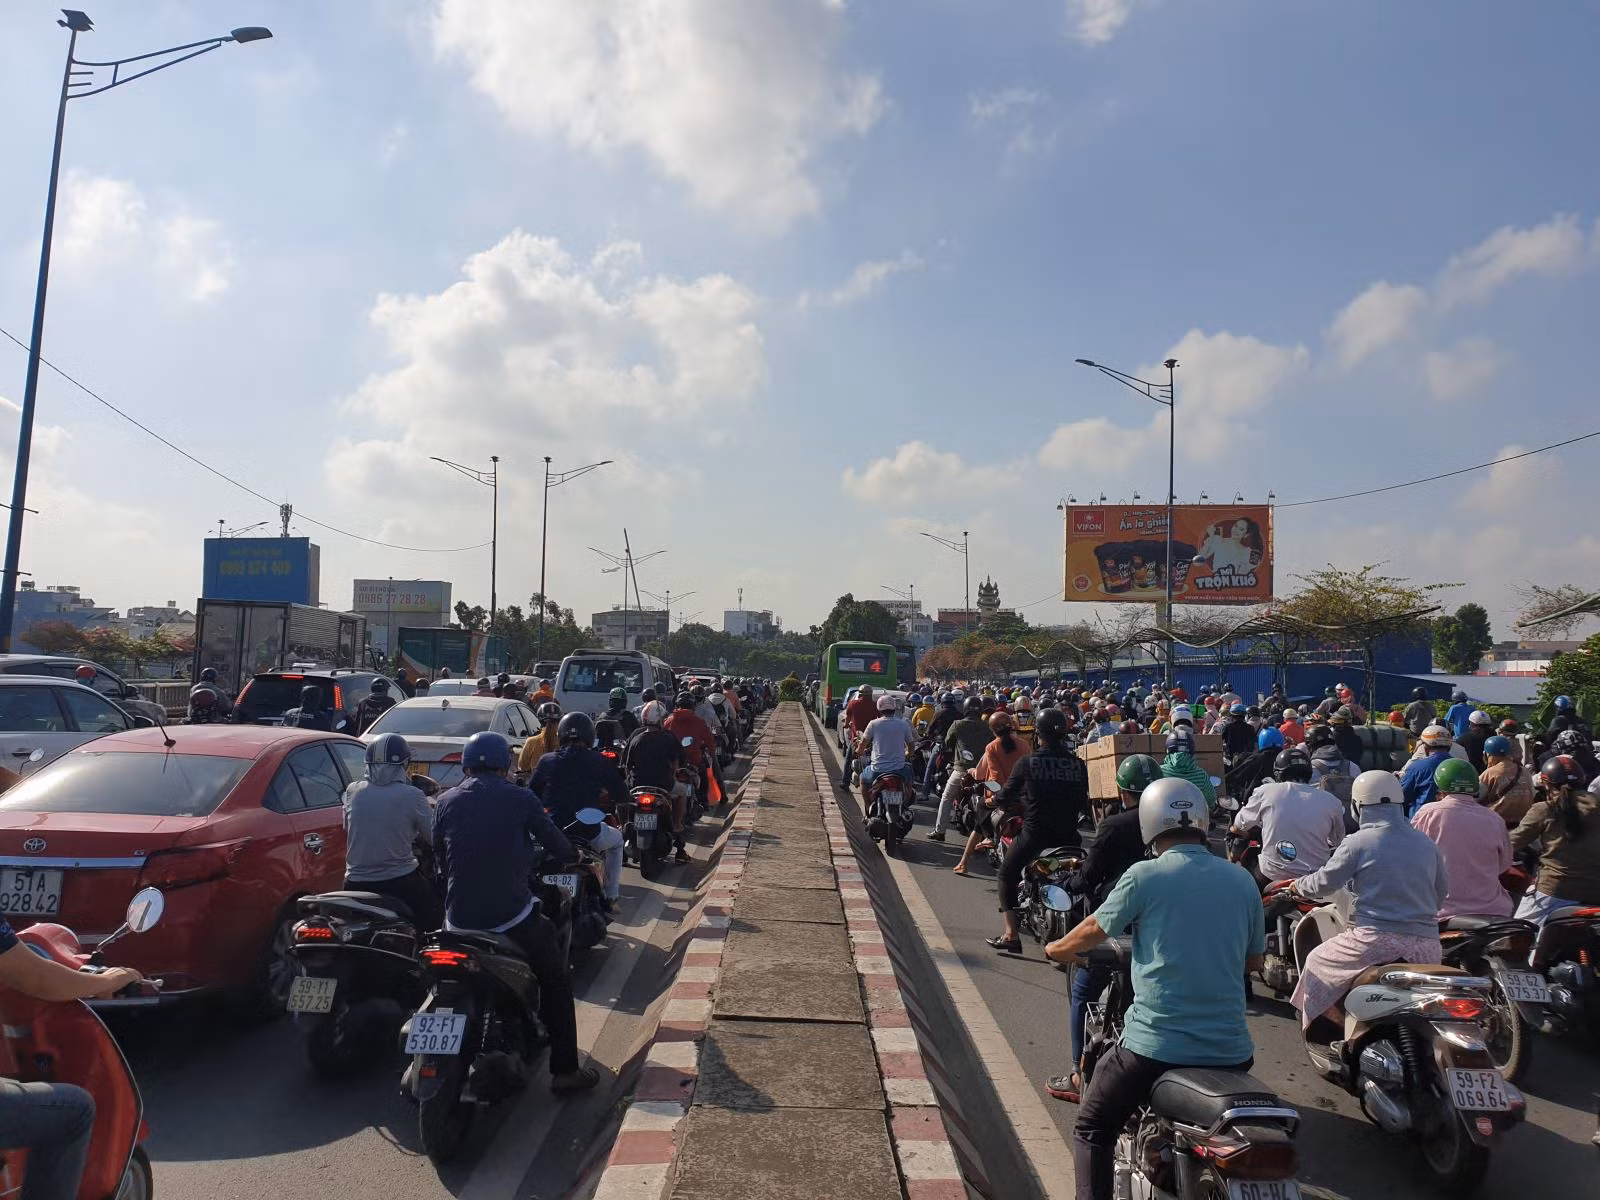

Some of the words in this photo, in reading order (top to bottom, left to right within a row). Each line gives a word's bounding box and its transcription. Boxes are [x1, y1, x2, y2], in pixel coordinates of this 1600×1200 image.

[1195, 573, 1230, 590] TRỘN
[1230, 573, 1257, 587] KHÔ
[400, 593, 411, 605] 28
[415, 594, 426, 605] 28
[1031, 768, 1082, 782] WHERE
[14, 872, 46, 892] 51A
[548, 875, 572, 886] 59-D2
[0, 892, 58, 913] 928.42
[299, 980, 330, 995] 59-Y1
[1507, 973, 1539, 988] 59-G2
[1508, 986, 1547, 1001] 075.37
[290, 994, 332, 1010] 557.25
[418, 1017, 456, 1034] 92-F1
[410, 1034, 459, 1051] 530.87
[1456, 1071, 1498, 1090] 59-F2
[1455, 1090, 1508, 1108] 069.64
